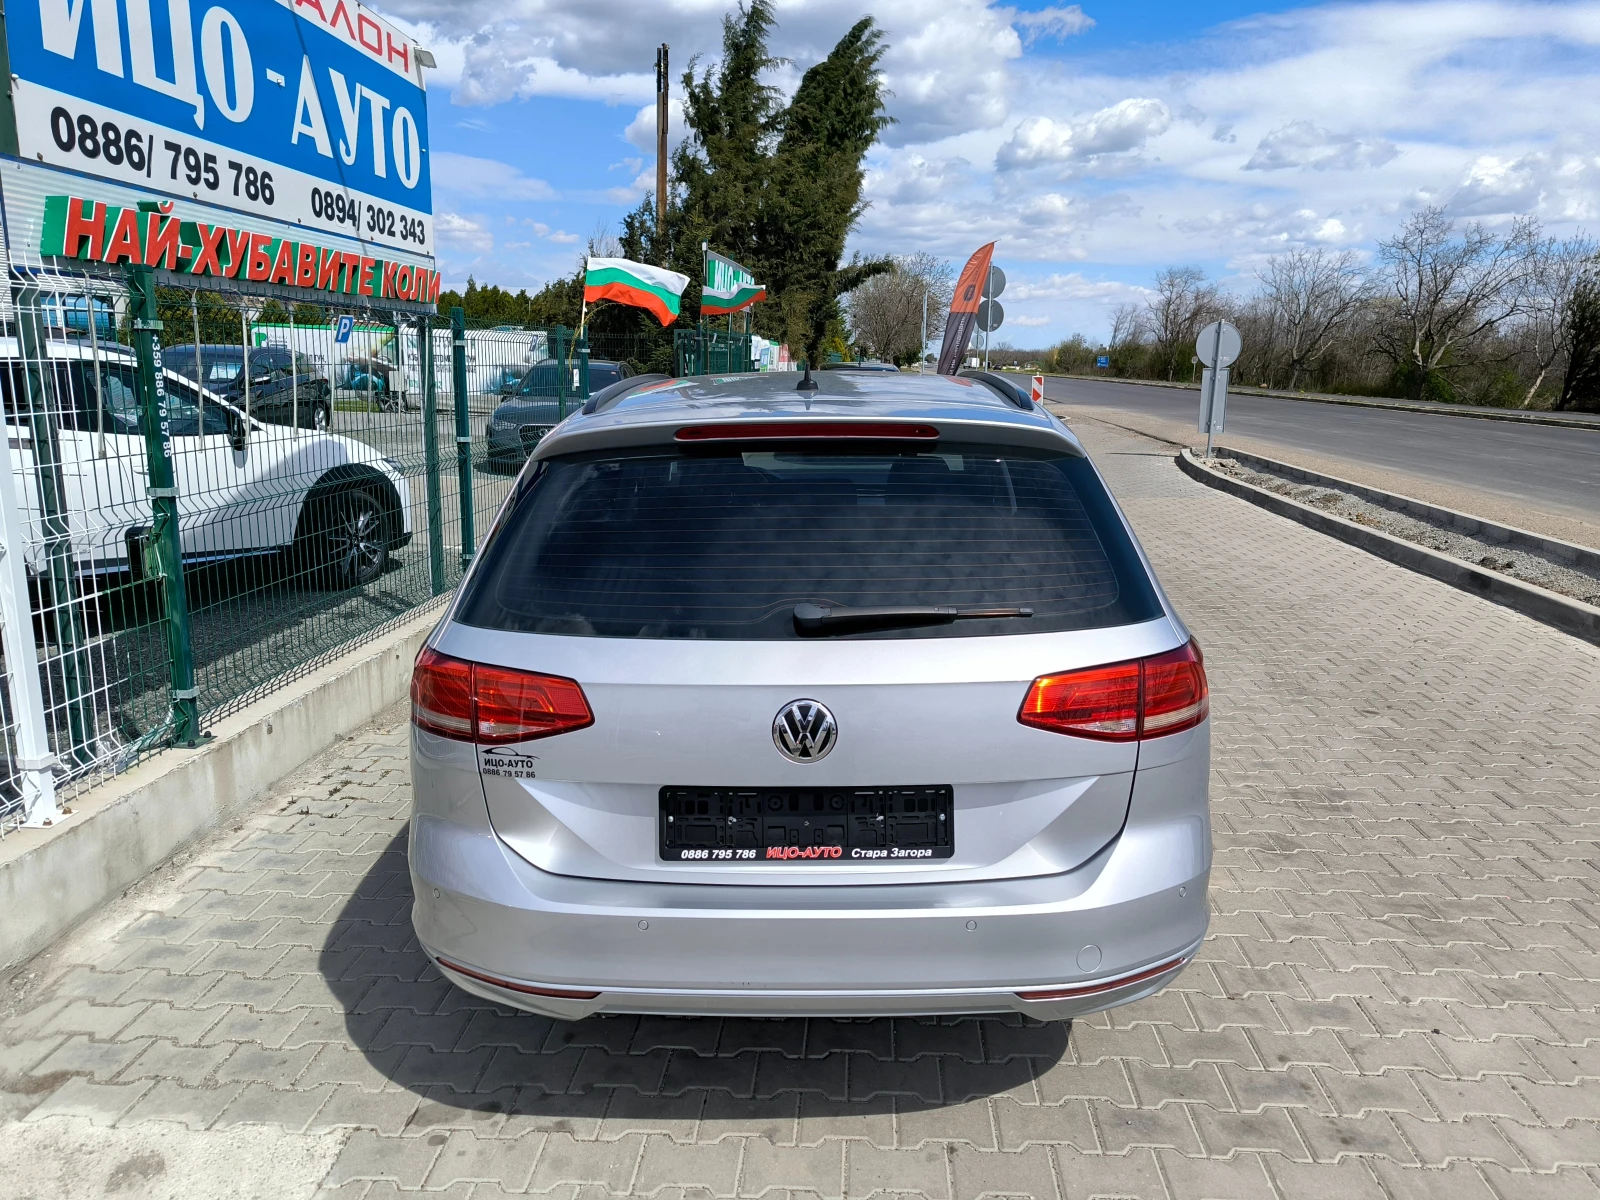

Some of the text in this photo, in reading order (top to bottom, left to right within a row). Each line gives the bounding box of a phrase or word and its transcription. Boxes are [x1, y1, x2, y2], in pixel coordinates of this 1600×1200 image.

[164, 140, 219, 190] 795
[228, 160, 274, 205] 786
[367, 205, 396, 237] 302
[400, 215, 425, 245] 343
[63, 196, 441, 305] НАЙ-ХУБАВИТЕ КОЛИ
[152, 334, 171, 457] +359 886 79 57 86
[484, 758, 533, 768] ИЦО-АУТО
[514, 770, 523, 778] 57
[681, 846, 932, 860] 0886 795 786 ИЦО-АУТО Стара Загора
